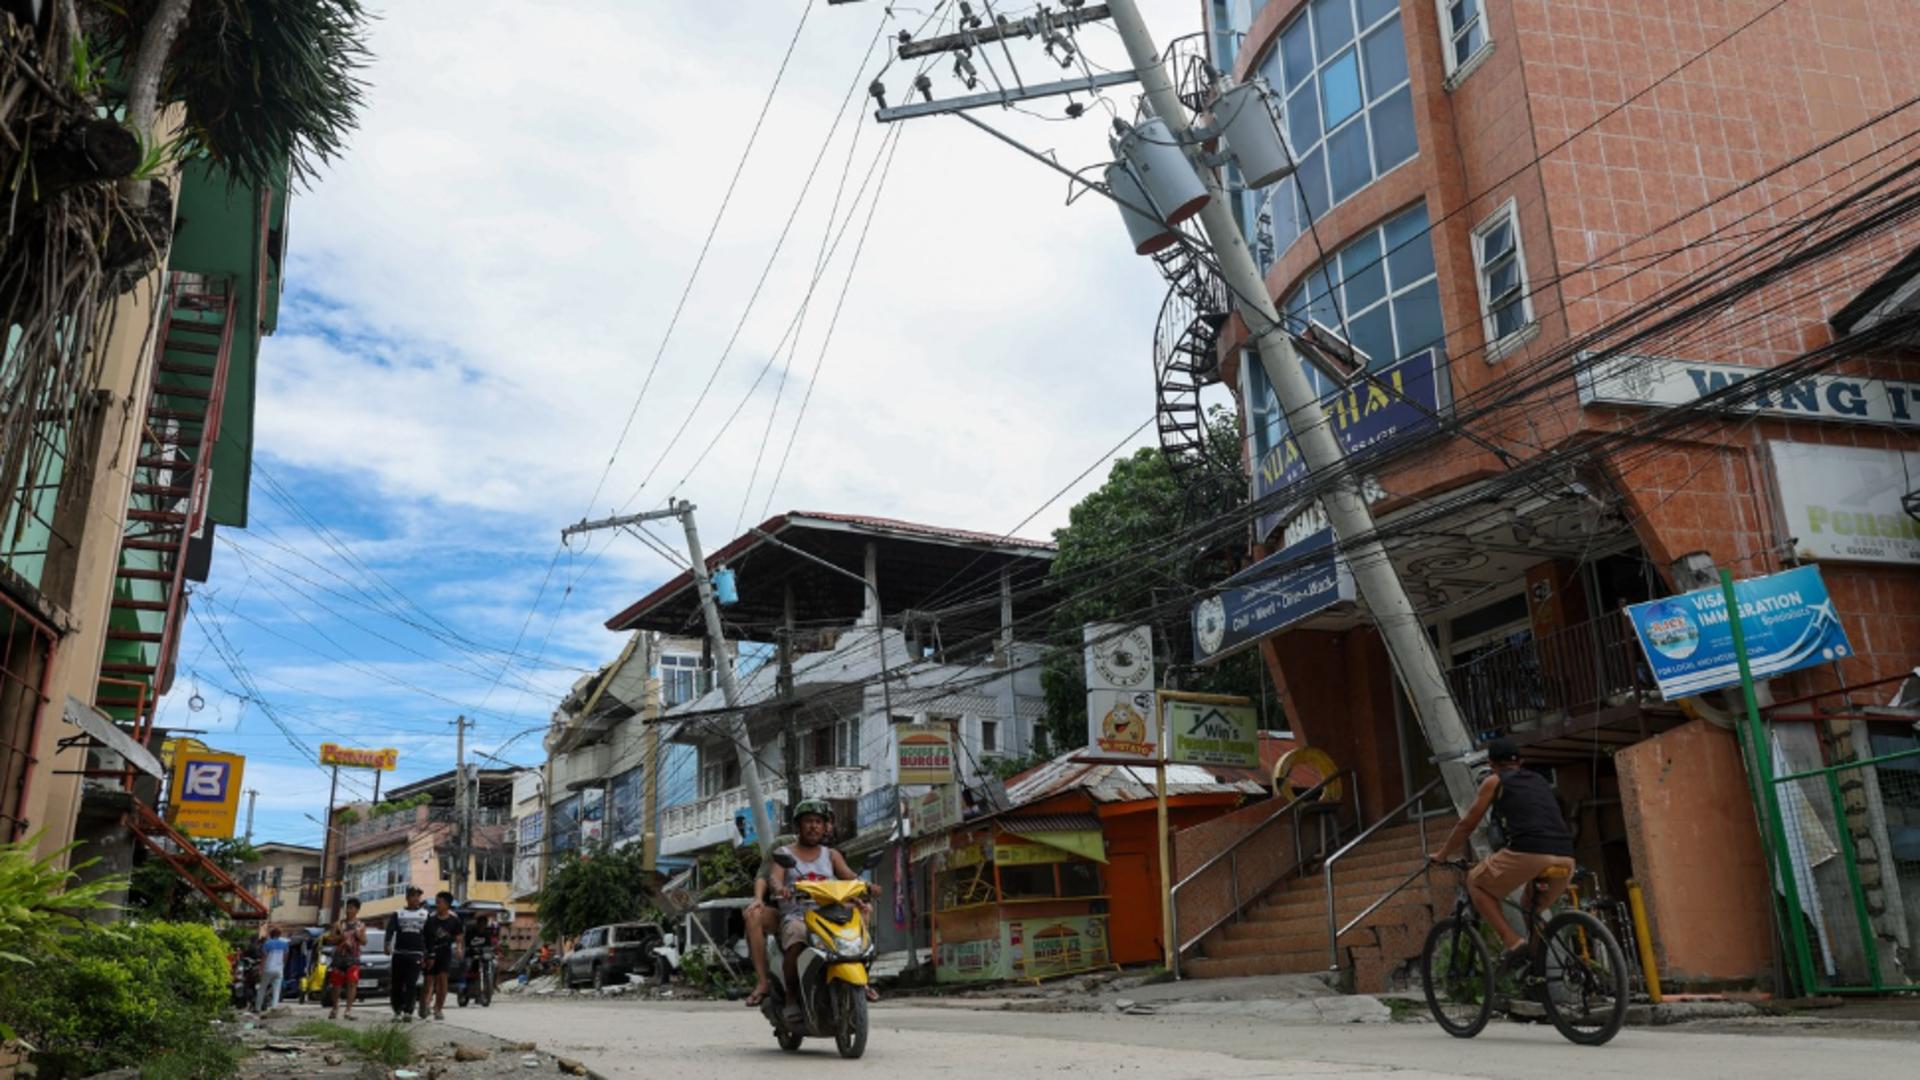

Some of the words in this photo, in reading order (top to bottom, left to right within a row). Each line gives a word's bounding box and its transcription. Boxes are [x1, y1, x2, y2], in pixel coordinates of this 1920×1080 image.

[1888, 386, 1920, 420] I
[1806, 505, 1920, 541] Pensi
[1692, 594, 1726, 611] VISA
[1698, 591, 1803, 627] IMMGRATION
[1204, 723, 1240, 740] Win's
[900, 756, 949, 766] BURGER
